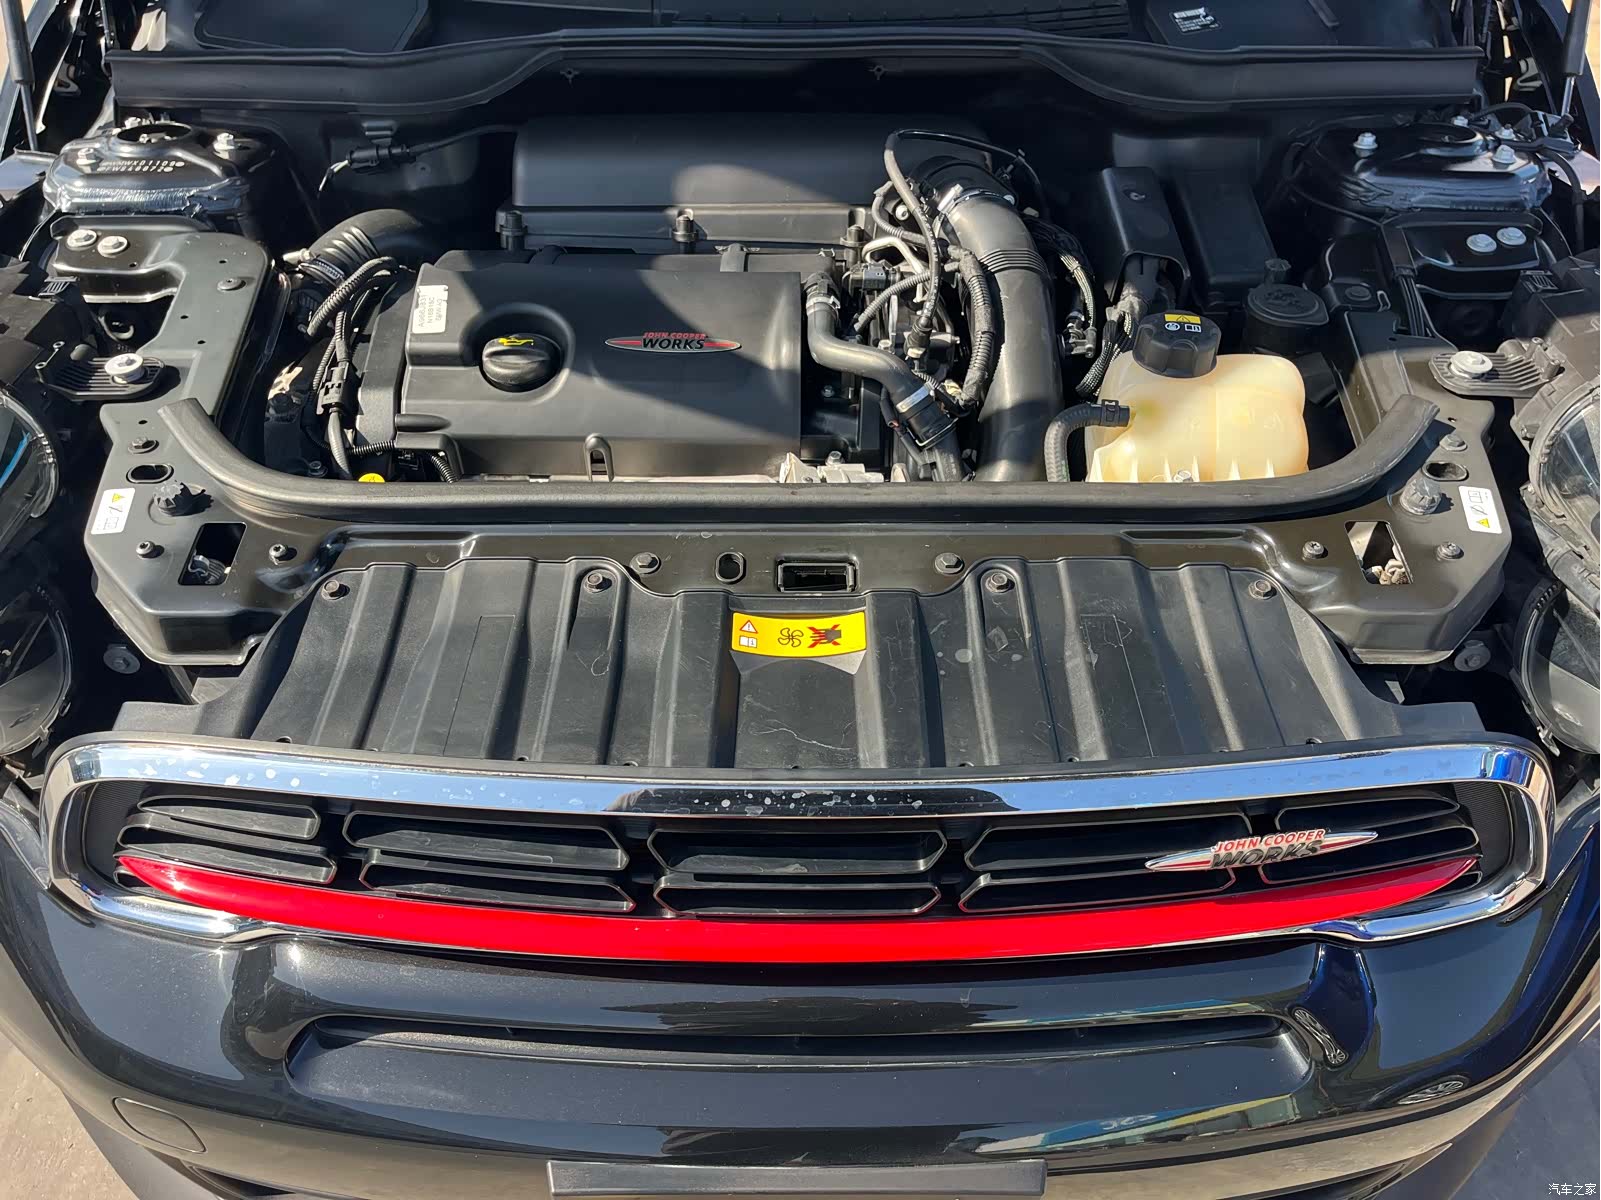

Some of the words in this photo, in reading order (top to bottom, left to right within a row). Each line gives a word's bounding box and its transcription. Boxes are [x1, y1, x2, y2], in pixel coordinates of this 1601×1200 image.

[642, 338, 705, 350] WORKS
[643, 331, 668, 339] JOHN
[669, 332, 706, 340] COOPER
[1216, 838, 1260, 853] JOHN
[1264, 830, 1325, 846] COOPER
[1211, 841, 1323, 868] WORKS
